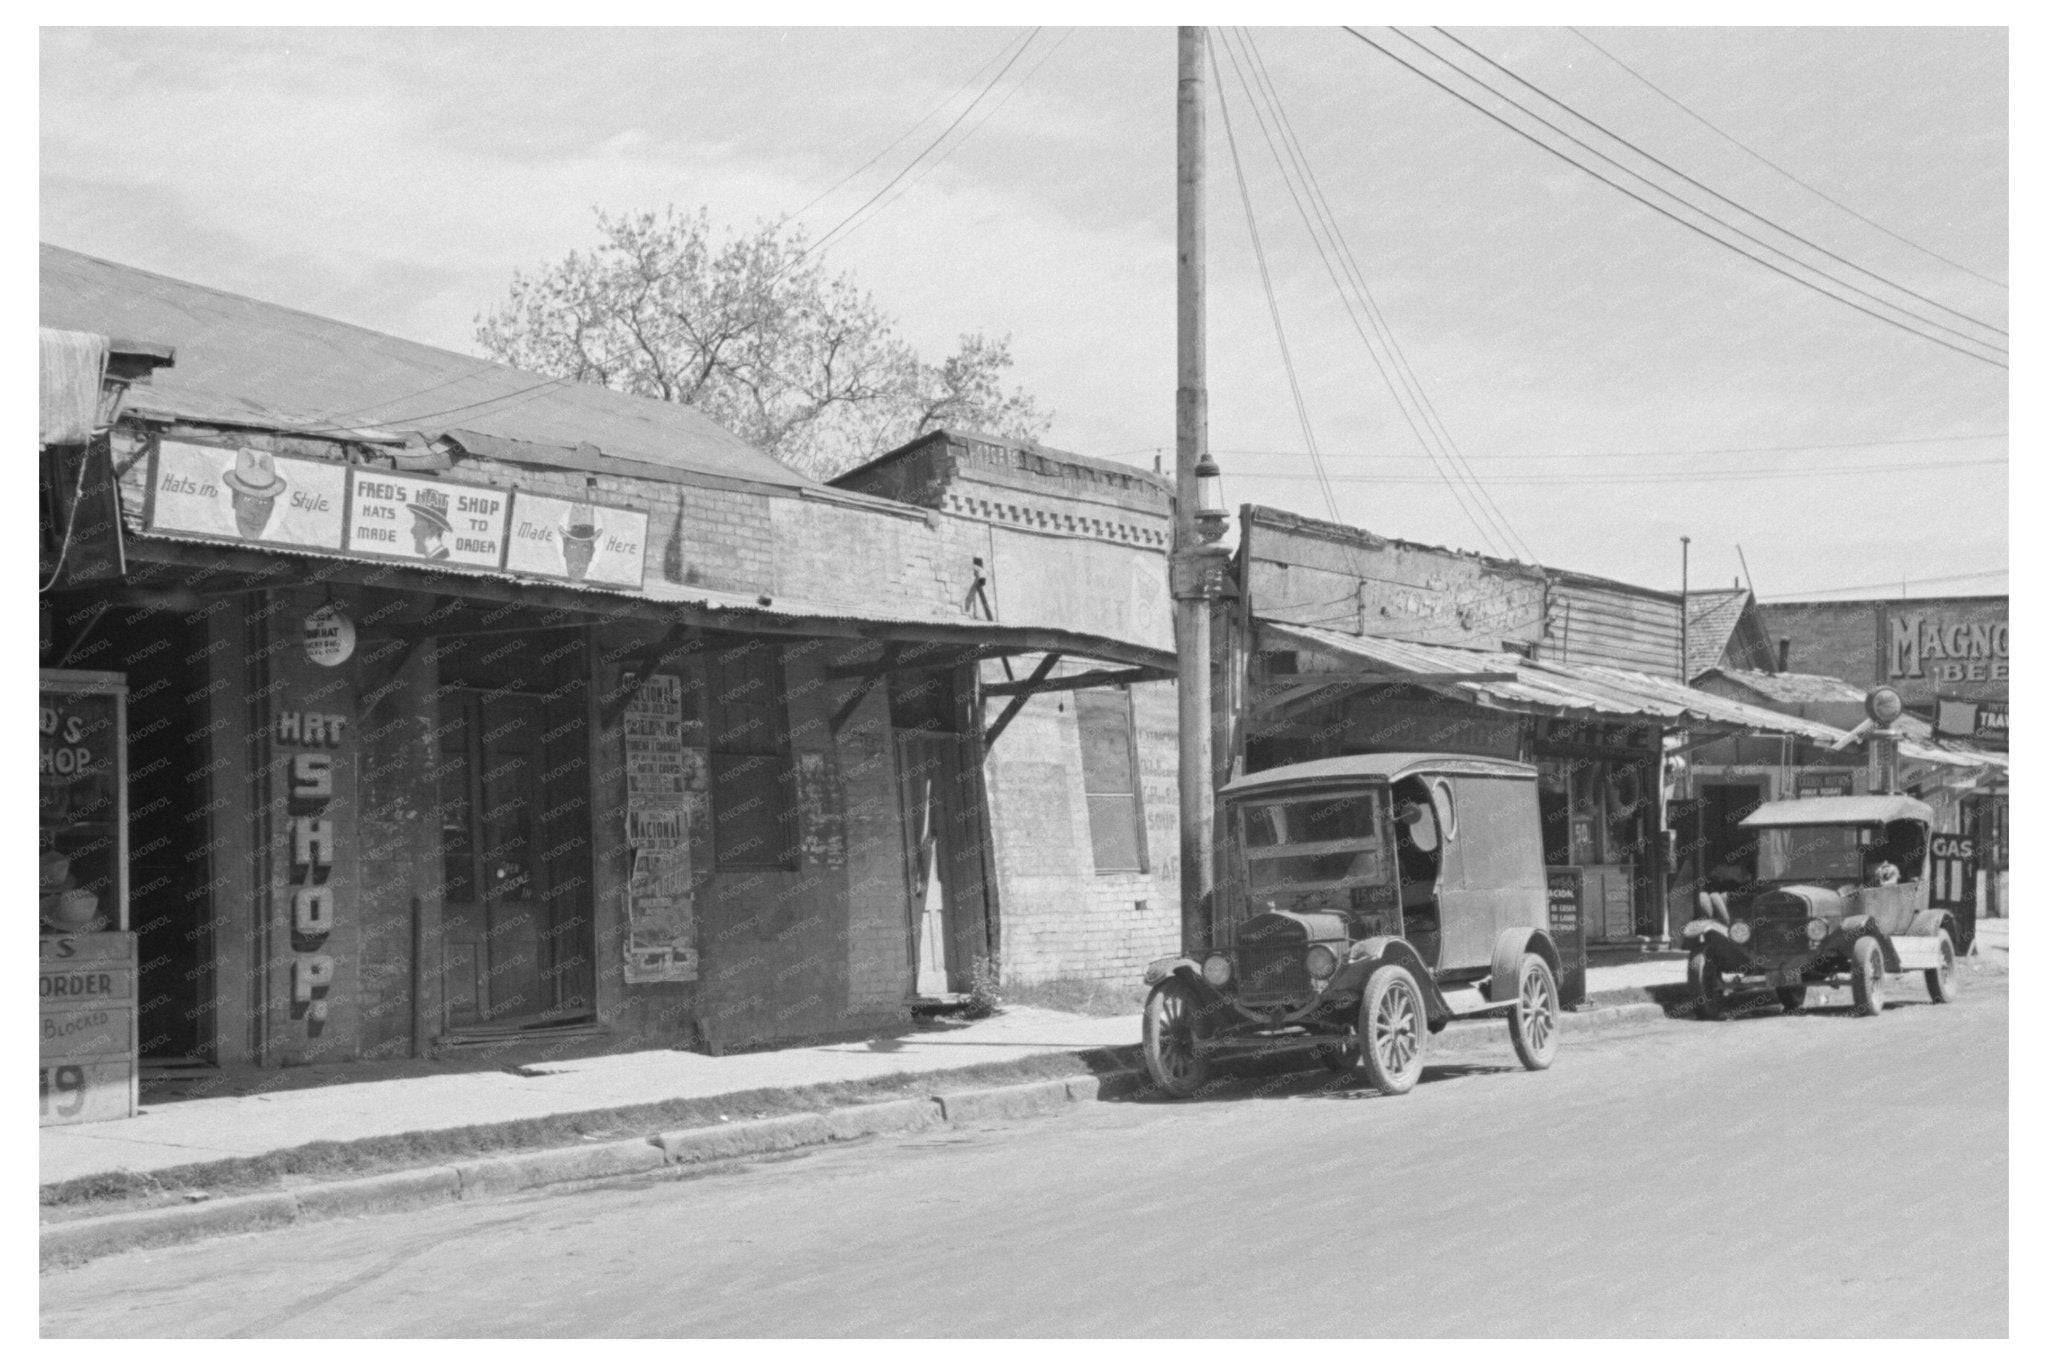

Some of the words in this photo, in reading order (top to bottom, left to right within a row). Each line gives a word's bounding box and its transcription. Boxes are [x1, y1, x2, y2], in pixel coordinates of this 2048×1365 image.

[160, 472, 196, 496] Hats
[289, 490, 330, 513] Style
[357, 481, 408, 503] FRED'S
[415, 488, 450, 508] HAT
[456, 495, 500, 516] SHOP
[362, 504, 397, 520] HATS
[357, 526, 397, 543] MADE
[468, 518, 489, 532] TO
[517, 520, 553, 542] Made
[455, 537, 497, 554] ORDER
[606, 534, 638, 555] Here
[1943, 663, 2009, 682] BEE
[279, 711, 347, 744] HAT
[1932, 837, 1973, 858] GAS
[39, 971, 112, 998] ORDER
